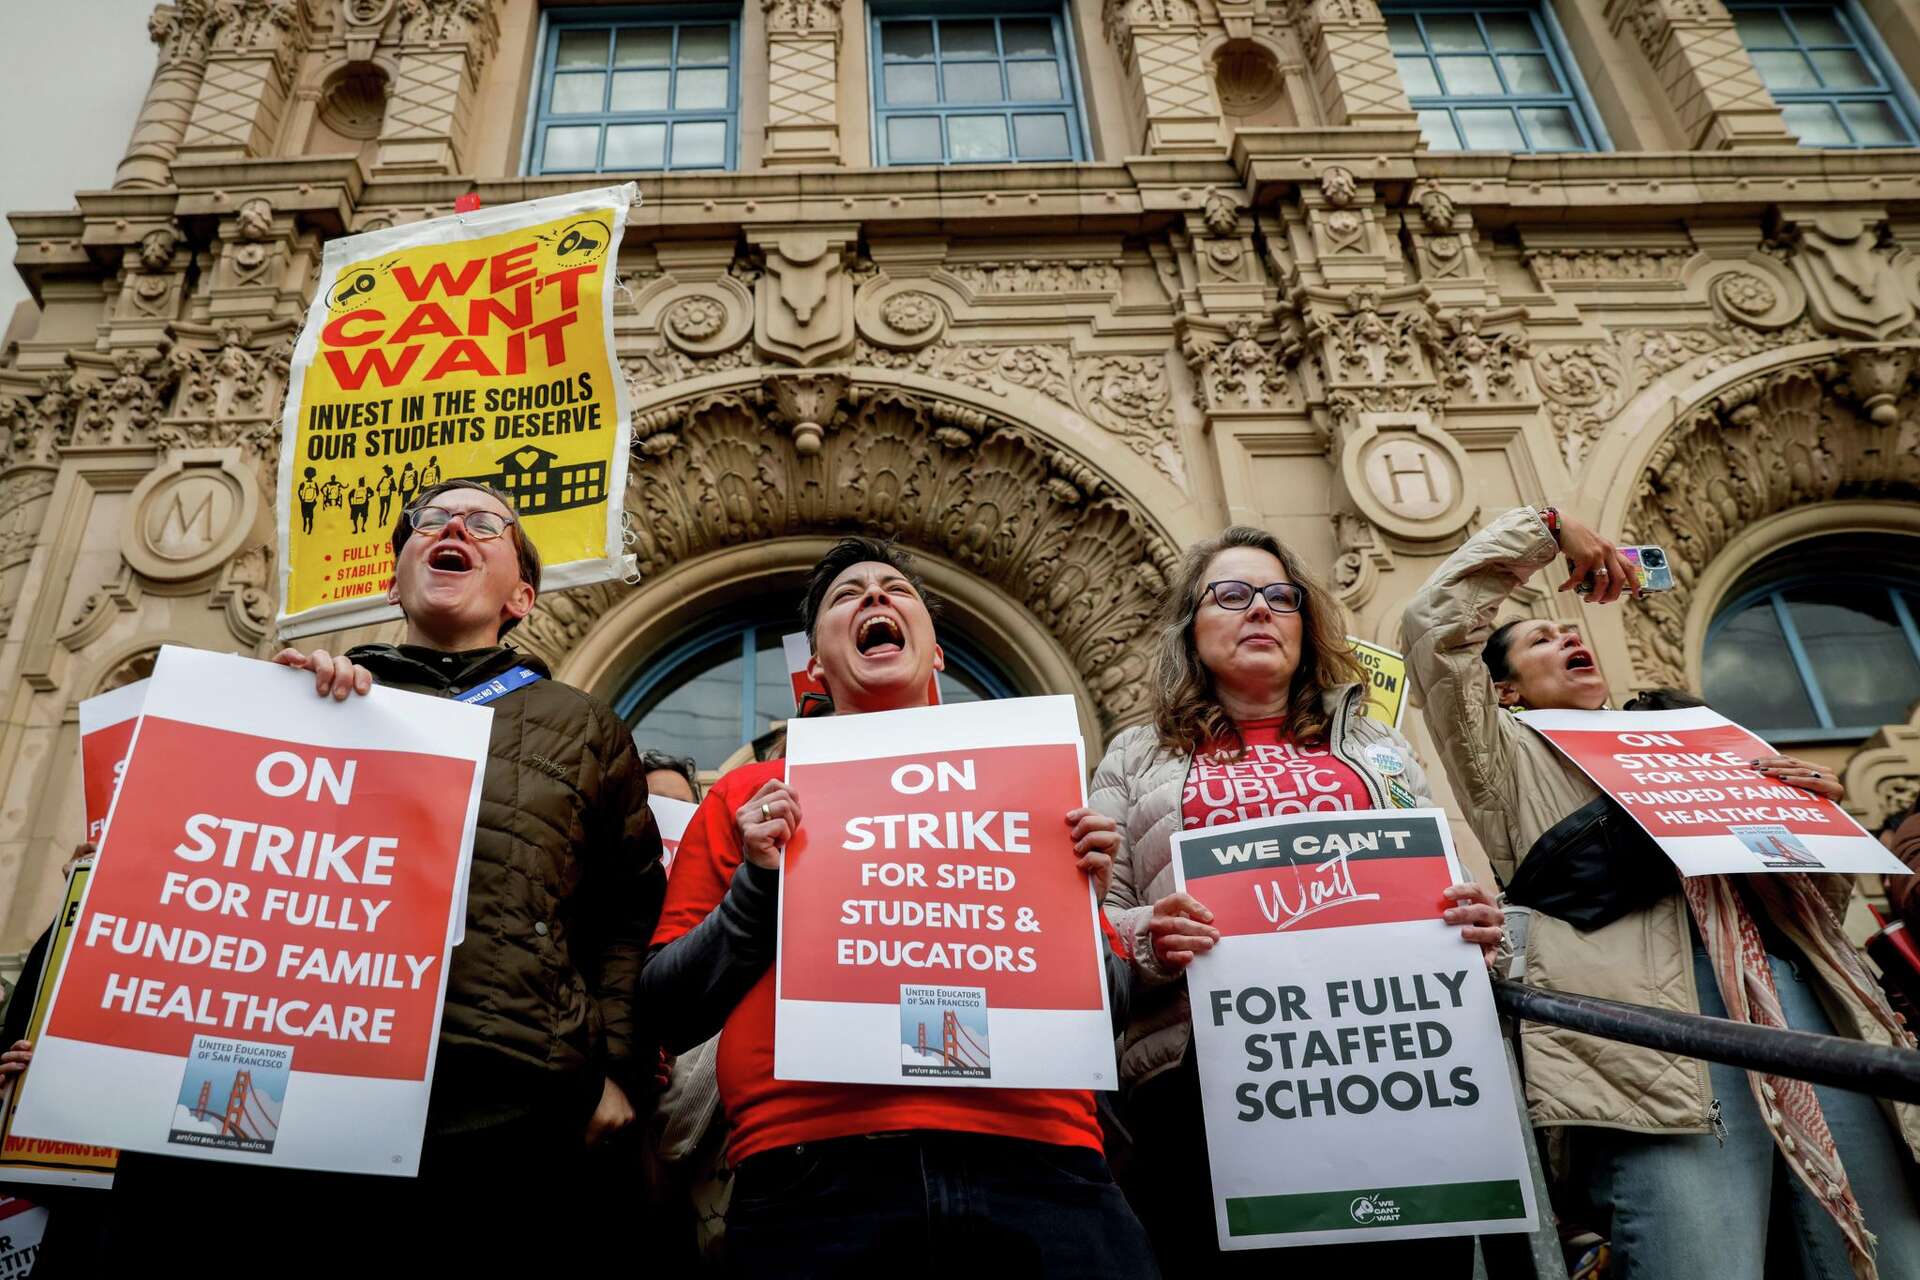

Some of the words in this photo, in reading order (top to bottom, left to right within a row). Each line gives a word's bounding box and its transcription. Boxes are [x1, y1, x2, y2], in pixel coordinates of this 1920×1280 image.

[391, 242, 539, 302] WE
[322, 265, 598, 348] CAN'T
[323, 311, 577, 391] WAIT
[309, 397, 393, 430] INVEST
[401, 394, 425, 423] IN
[433, 389, 476, 417] THE
[484, 372, 593, 413] SCHOOLS
[307, 431, 357, 461] OUR
[365, 418, 486, 457] STUDENTS
[494, 403, 601, 440] DESERVE
[1382, 453, 1440, 503] H
[154, 489, 214, 542] M
[343, 543, 380, 562] FULLY
[333, 581, 373, 599] LIVING
[1616, 733, 1684, 748] ON
[255, 750, 357, 806] ON
[890, 759, 976, 796] ON
[1612, 751, 1751, 770] STRIKE
[1631, 771, 1692, 785] FOR
[1617, 787, 1726, 805] FUNDED
[842, 811, 1031, 855] STRIKE
[1655, 806, 1831, 825] HEALTHCARE
[173, 813, 398, 887] STRIKE
[1211, 838, 1282, 866] WE
[1292, 828, 1412, 857] CAN'T
[860, 862, 929, 890] FOR
[936, 862, 1017, 893] SPED
[159, 871, 252, 919] FOR
[261, 888, 392, 933] FULLY
[840, 898, 1006, 933] STUDENTS
[1013, 906, 1042, 934] &
[84, 911, 268, 974] FUNDED
[276, 943, 436, 992] FAMILY
[836, 938, 1038, 974] EDUCATORS
[100, 973, 397, 1045] HEALTHCARE
[905, 988, 935, 997] UNITED
[936, 989, 981, 999] EDUCATORS
[919, 997, 936, 1006] SAN
[937, 998, 980, 1008] FRANCISCO
[1209, 984, 1313, 1027] FOR
[1325, 970, 1469, 1018] FULLY
[198, 1039, 233, 1053] UNITED
[235, 1043, 288, 1060] EDUCATORS
[211, 1051, 232, 1064] SAN
[233, 1054, 283, 1069] FRANCISCO
[1244, 1020, 1454, 1073] STAFFED
[1236, 1066, 1480, 1124] SCHOOLS
[1376, 1214, 1401, 1222] WAIT
[1378, 1200, 1394, 1208] WE
